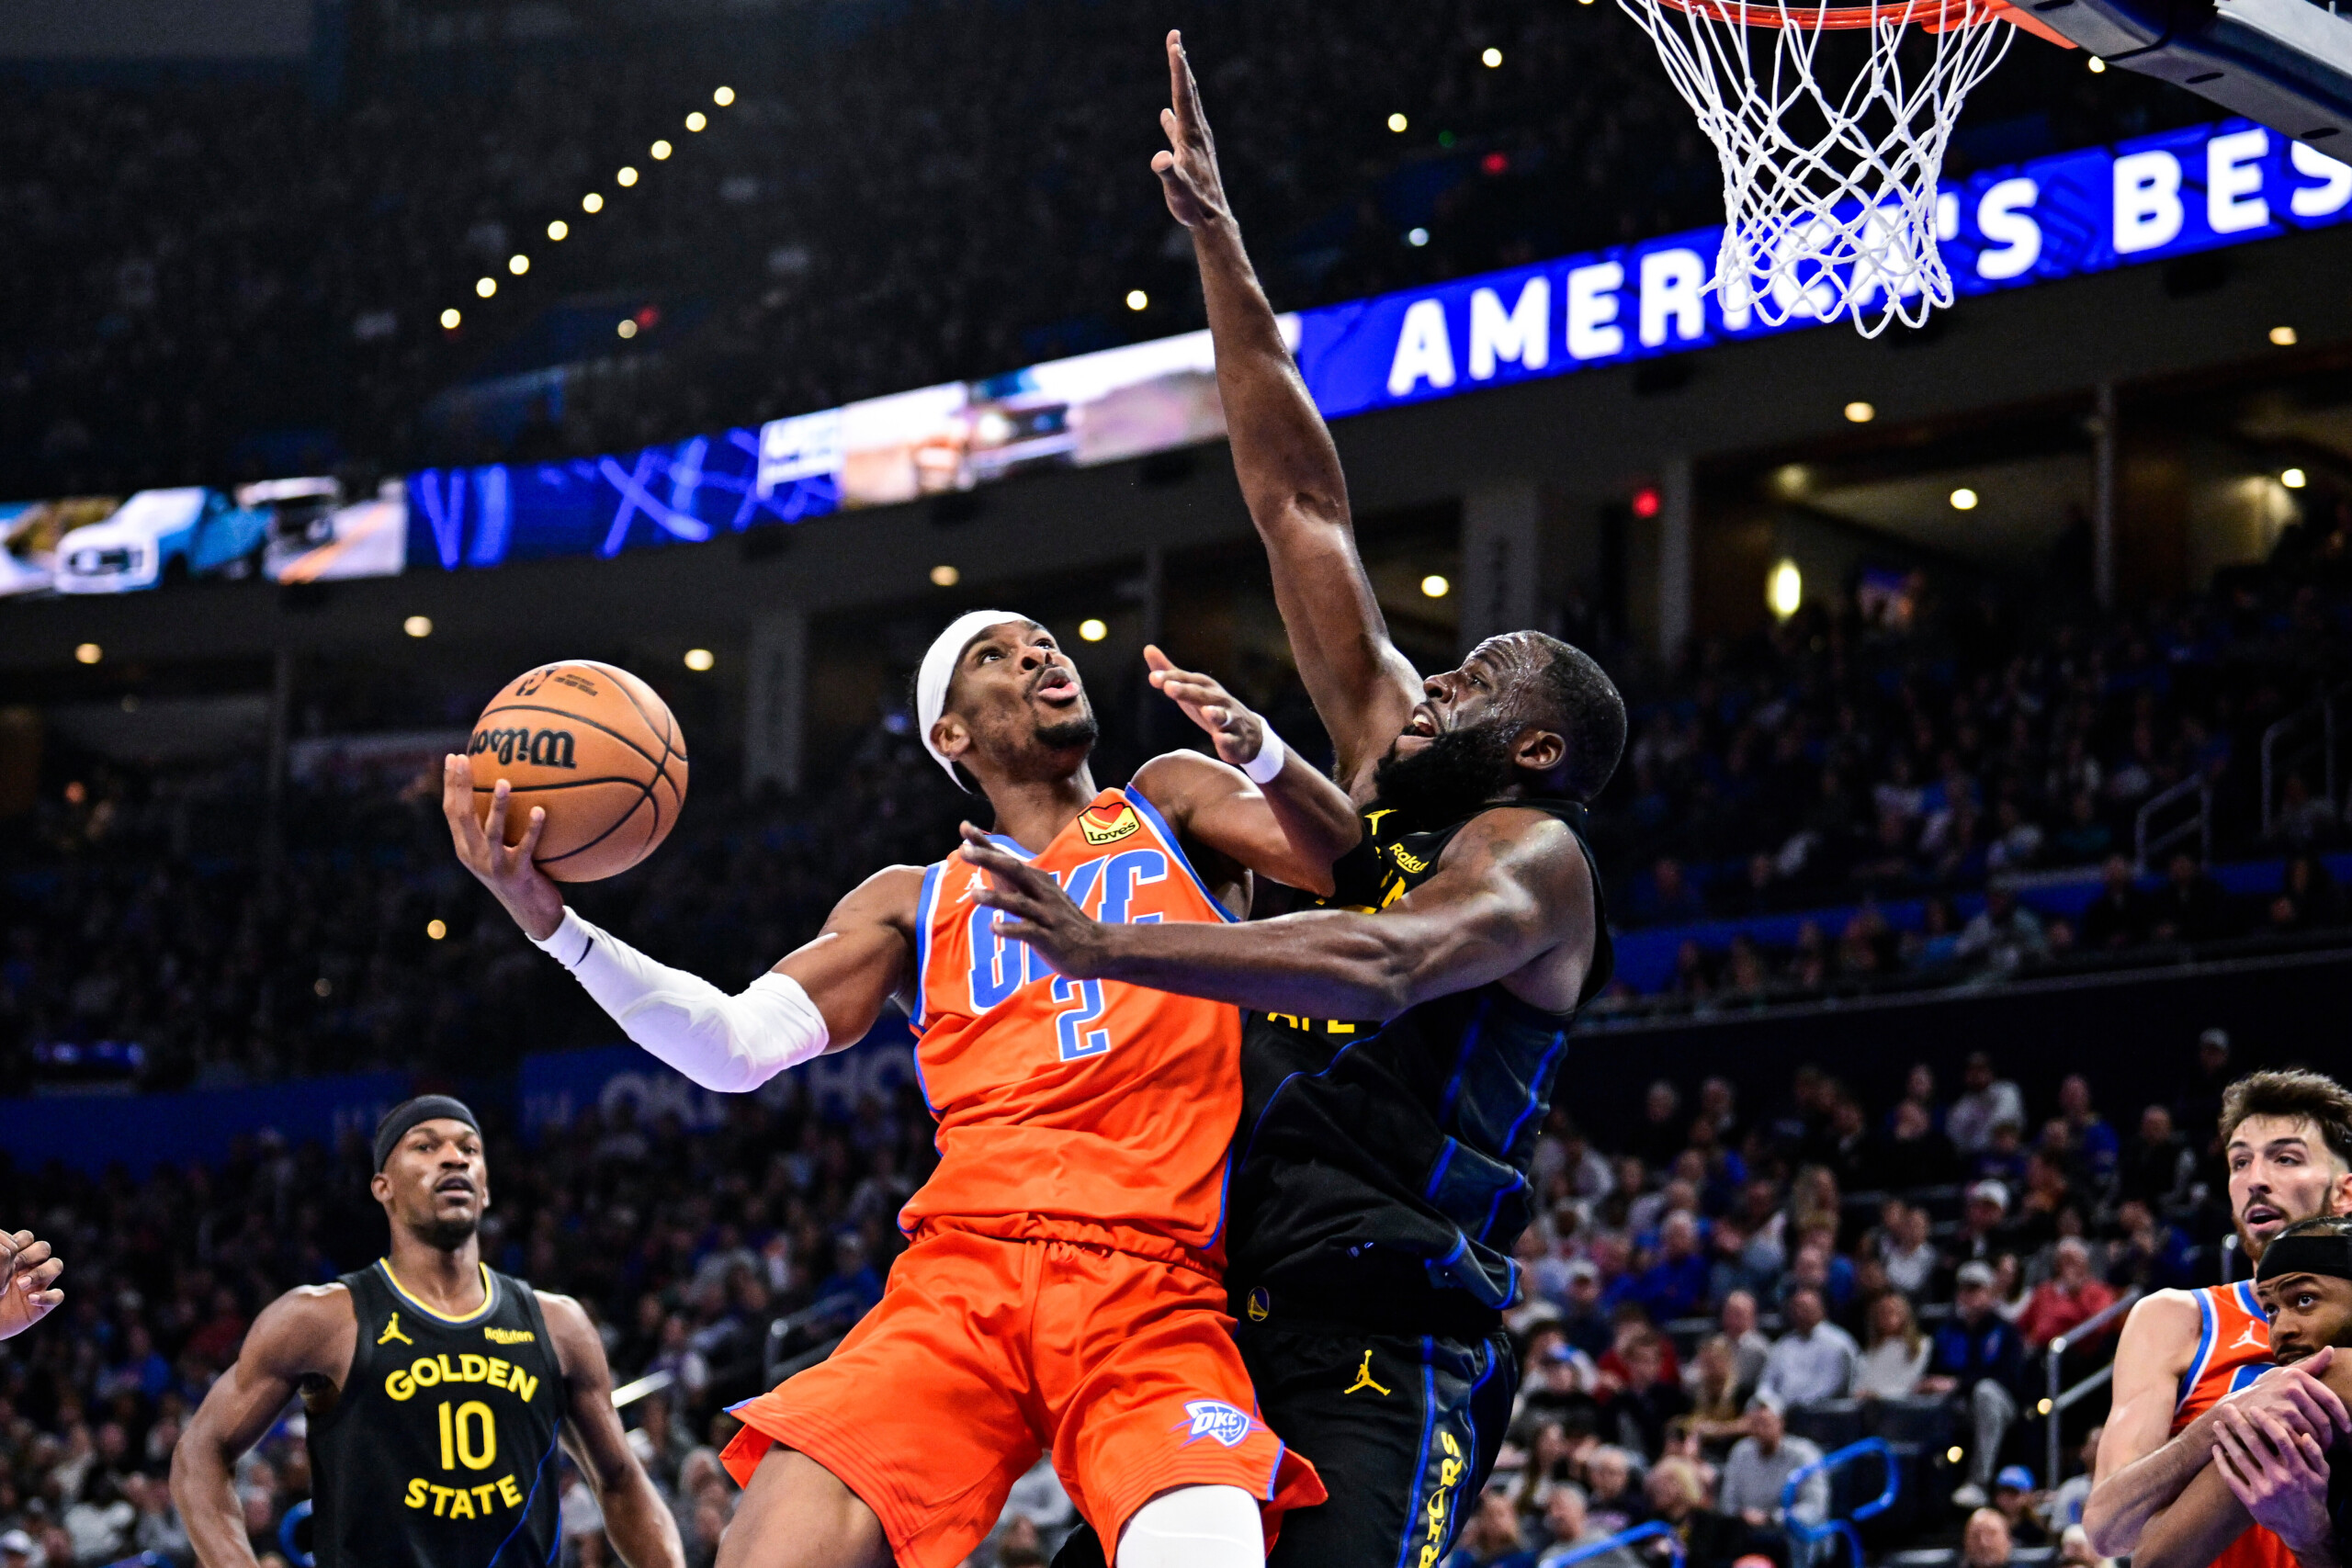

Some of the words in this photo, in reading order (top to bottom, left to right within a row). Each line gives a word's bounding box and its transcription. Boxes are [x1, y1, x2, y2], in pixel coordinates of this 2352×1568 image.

[1387, 176, 2042, 397] AMERICA'S
[1049, 970, 1111, 1063] 2
[483, 1325, 536, 1345] Rakuten
[384, 1353, 539, 1403] GOLDEN
[437, 1400, 497, 1471] 10
[1191, 1412, 1238, 1436] OKC
[403, 1473, 524, 1519] STATE
